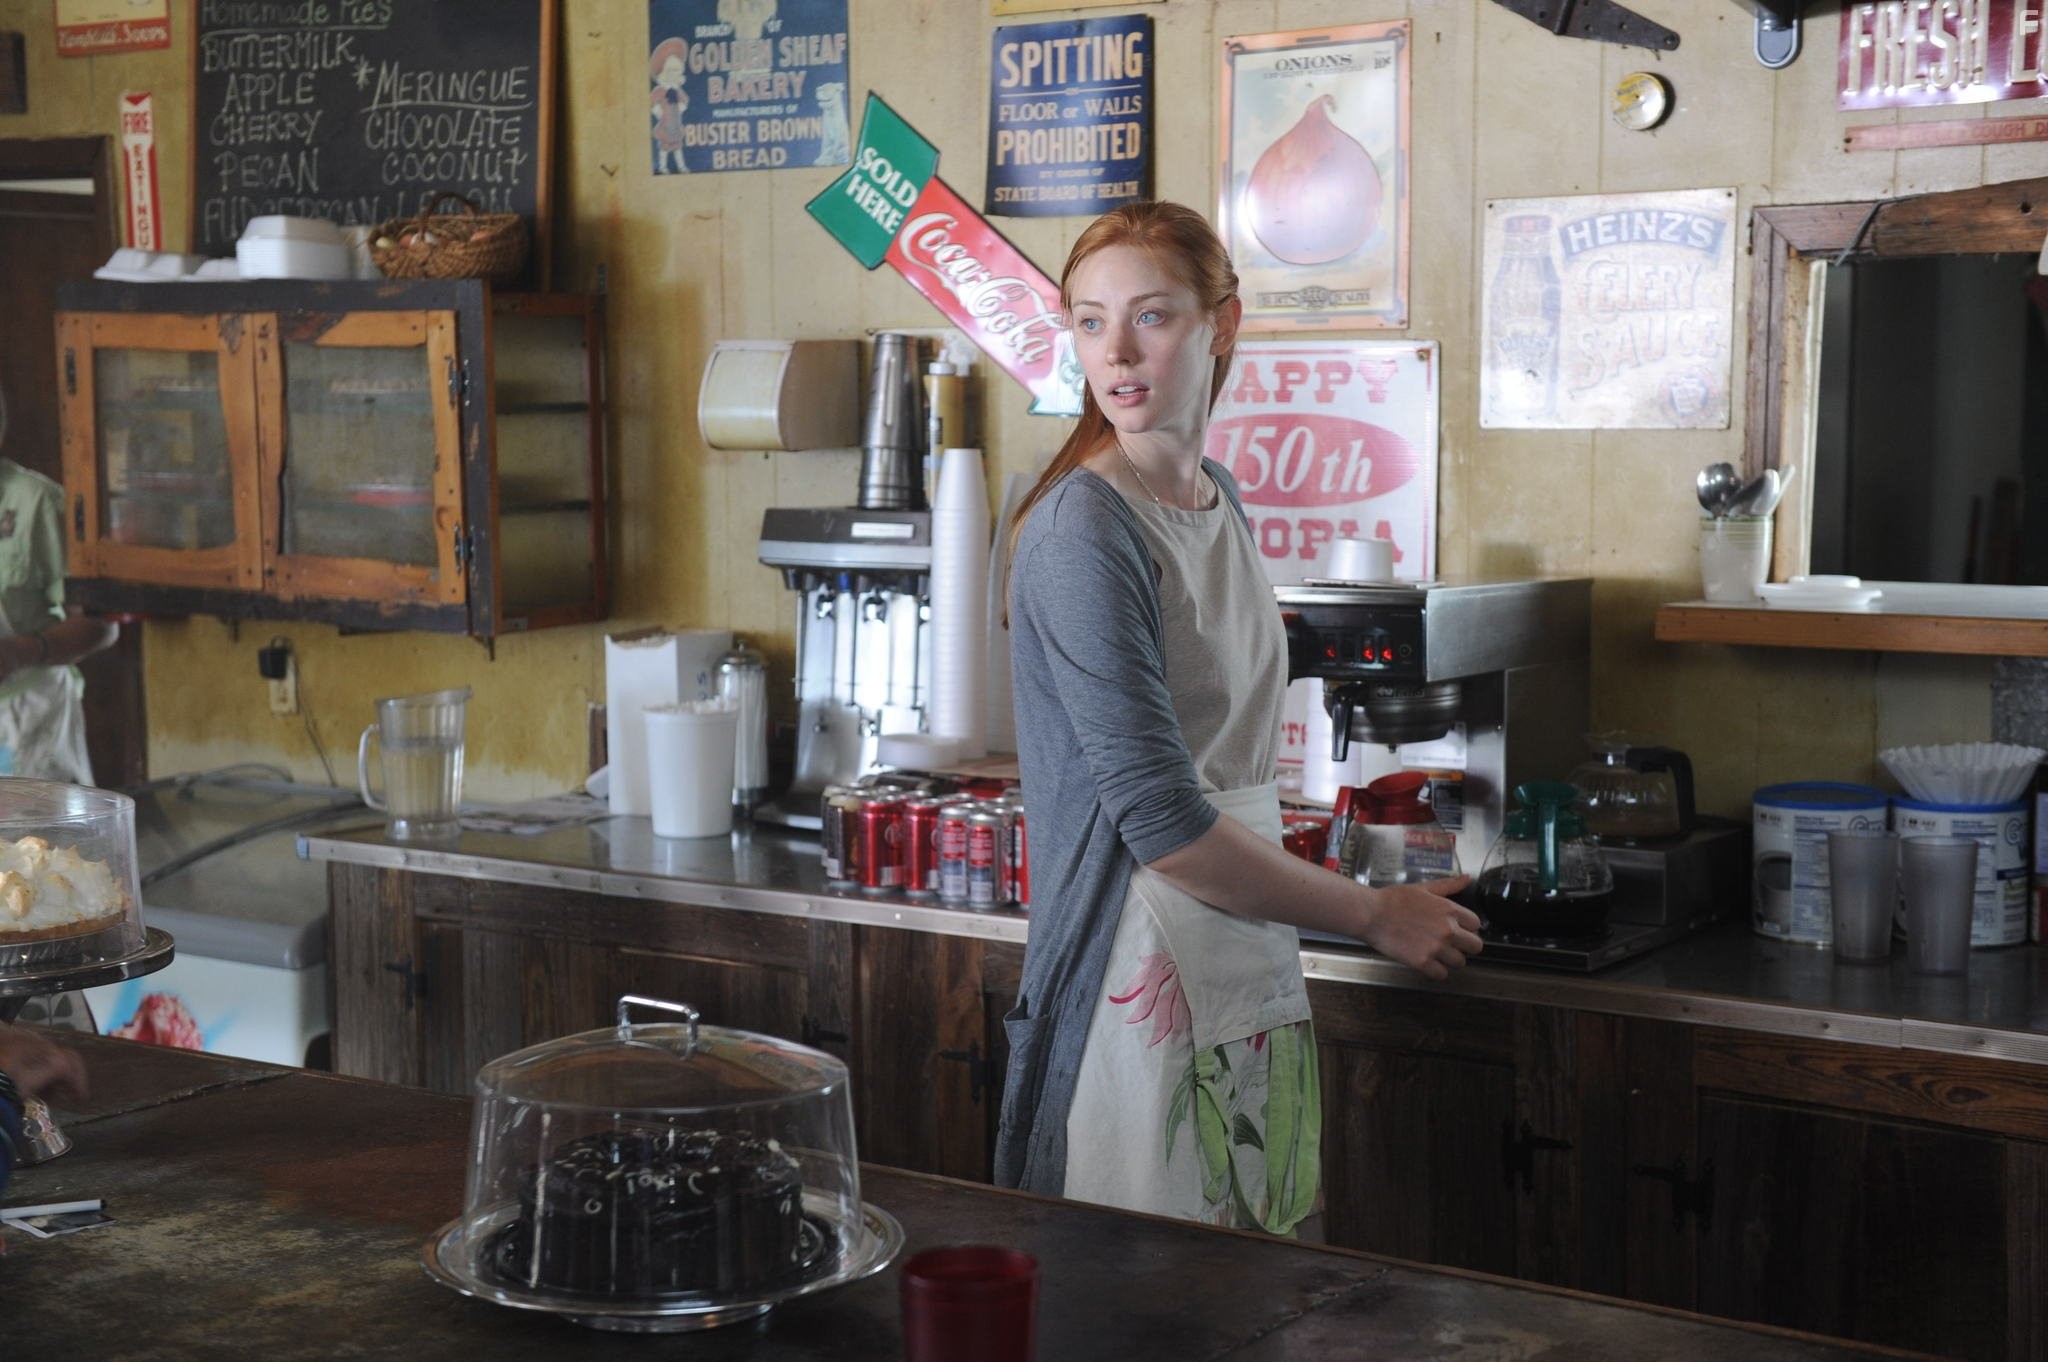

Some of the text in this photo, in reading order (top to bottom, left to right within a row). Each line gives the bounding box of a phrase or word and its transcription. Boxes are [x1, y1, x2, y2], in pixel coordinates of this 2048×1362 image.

[202, 0, 392, 25] Homemade Pies
[201, 32, 356, 71] BUTTERMILK
[689, 33, 847, 74] GOLDEN SHEAF
[1001, 32, 1144, 88] SPITTING
[1275, 54, 1352, 71] ONIONS
[1847, 0, 1990, 95] FRESH
[222, 72, 314, 113] APPLE
[708, 71, 807, 104] BAKERY
[122, 112, 150, 134] FIRE
[210, 109, 323, 146] CHERRY
[365, 109, 521, 149] CHOCOLATE
[998, 102, 1058, 122] FLOOR
[1084, 96, 1143, 117] WALLS
[685, 117, 823, 147] BUSTER BROWN
[996, 122, 1141, 166] PROHIBITED
[214, 148, 319, 193] PECAN
[712, 147, 788, 169] BREAD
[859, 147, 919, 208] SOLD
[845, 173, 904, 234] HERE
[994, 186, 1037, 201] STATE
[1567, 210, 1717, 254] HEINZ'S
[900, 212, 1067, 363] Coca-Cola
[1222, 360, 1398, 403] APPY
